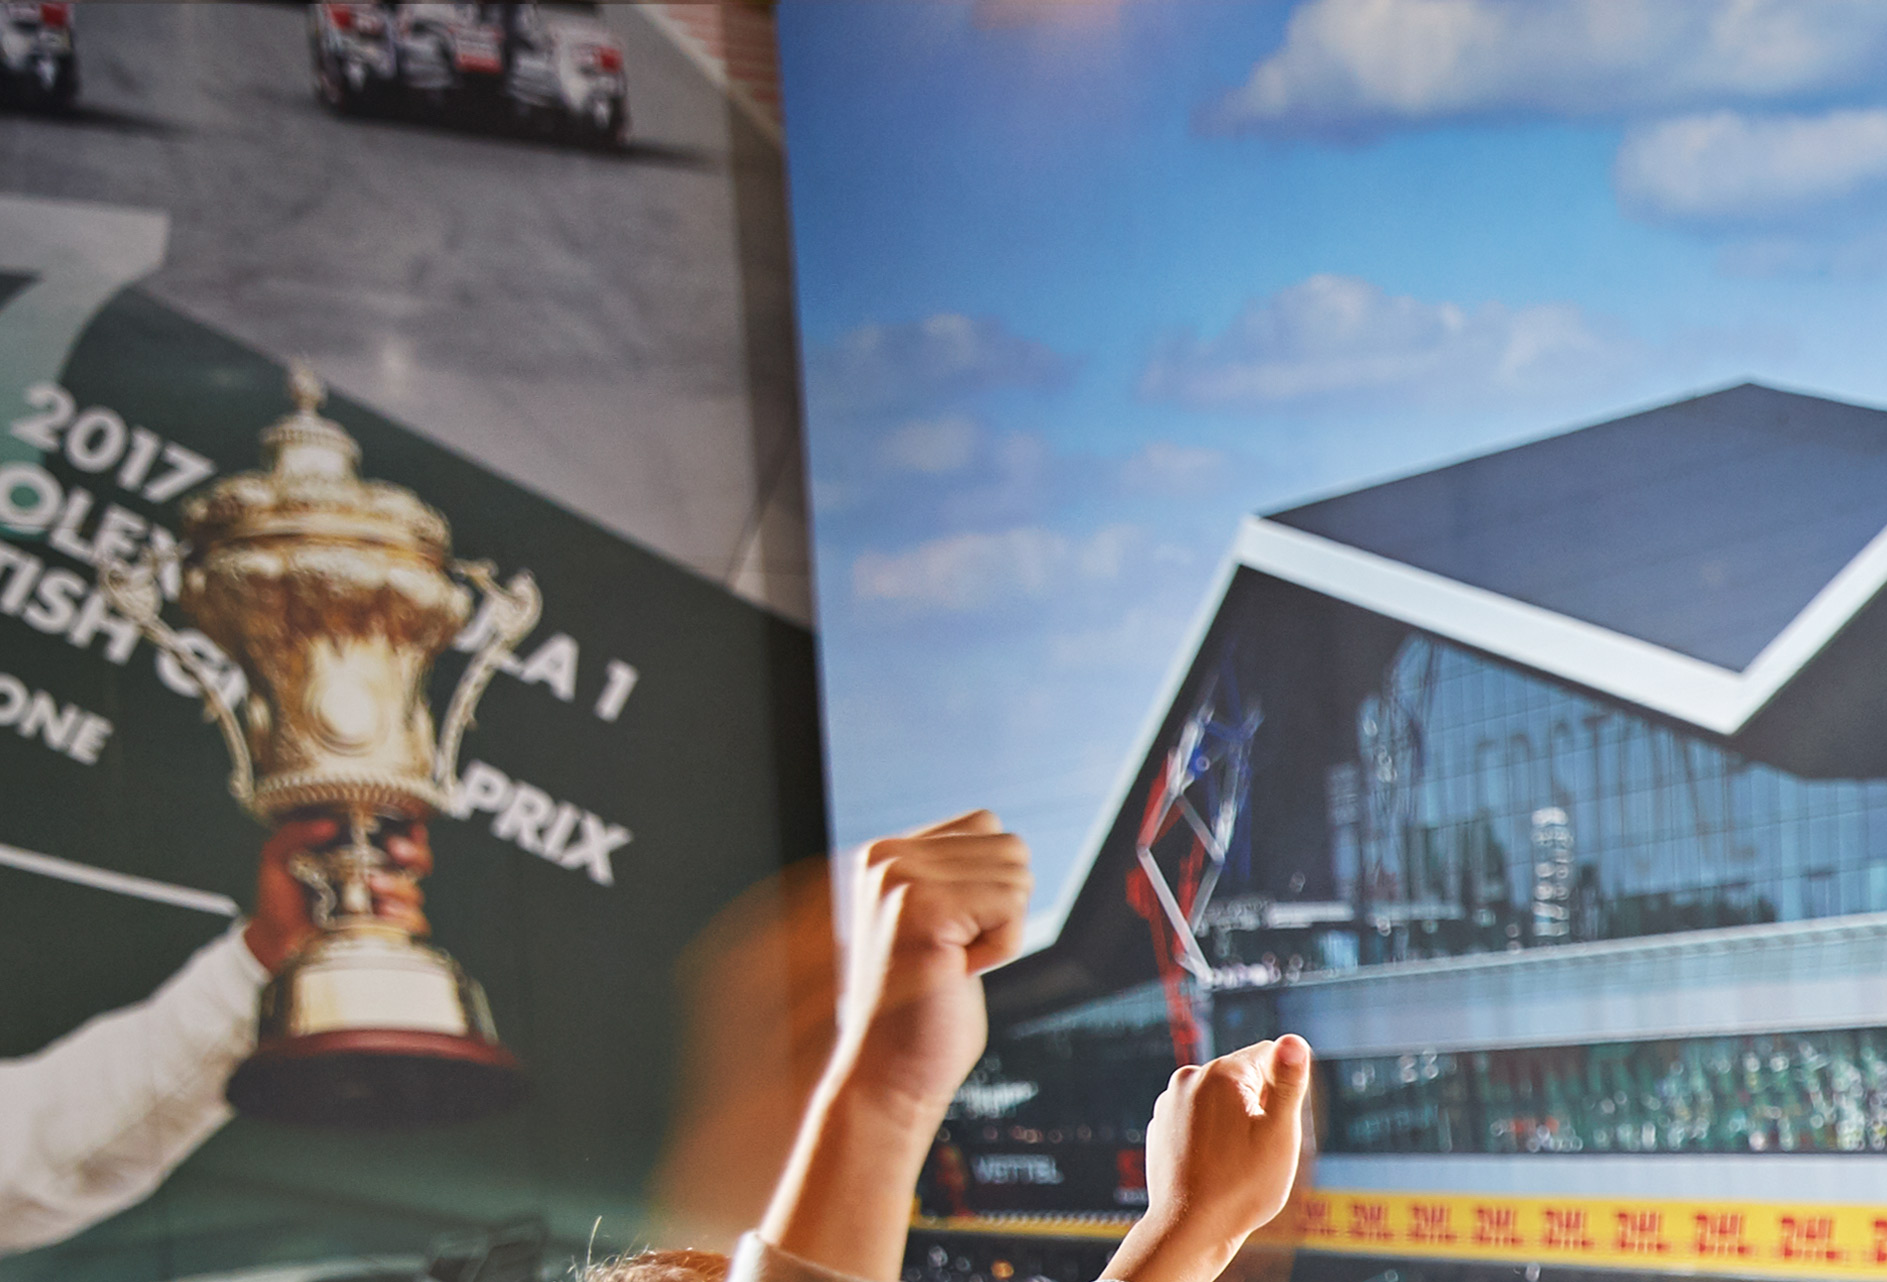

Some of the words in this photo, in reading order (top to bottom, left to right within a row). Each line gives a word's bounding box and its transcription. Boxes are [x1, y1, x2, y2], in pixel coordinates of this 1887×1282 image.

[12, 384, 214, 504] 2017
[0, 462, 192, 597] OLEX
[447, 759, 634, 884] PRIX
